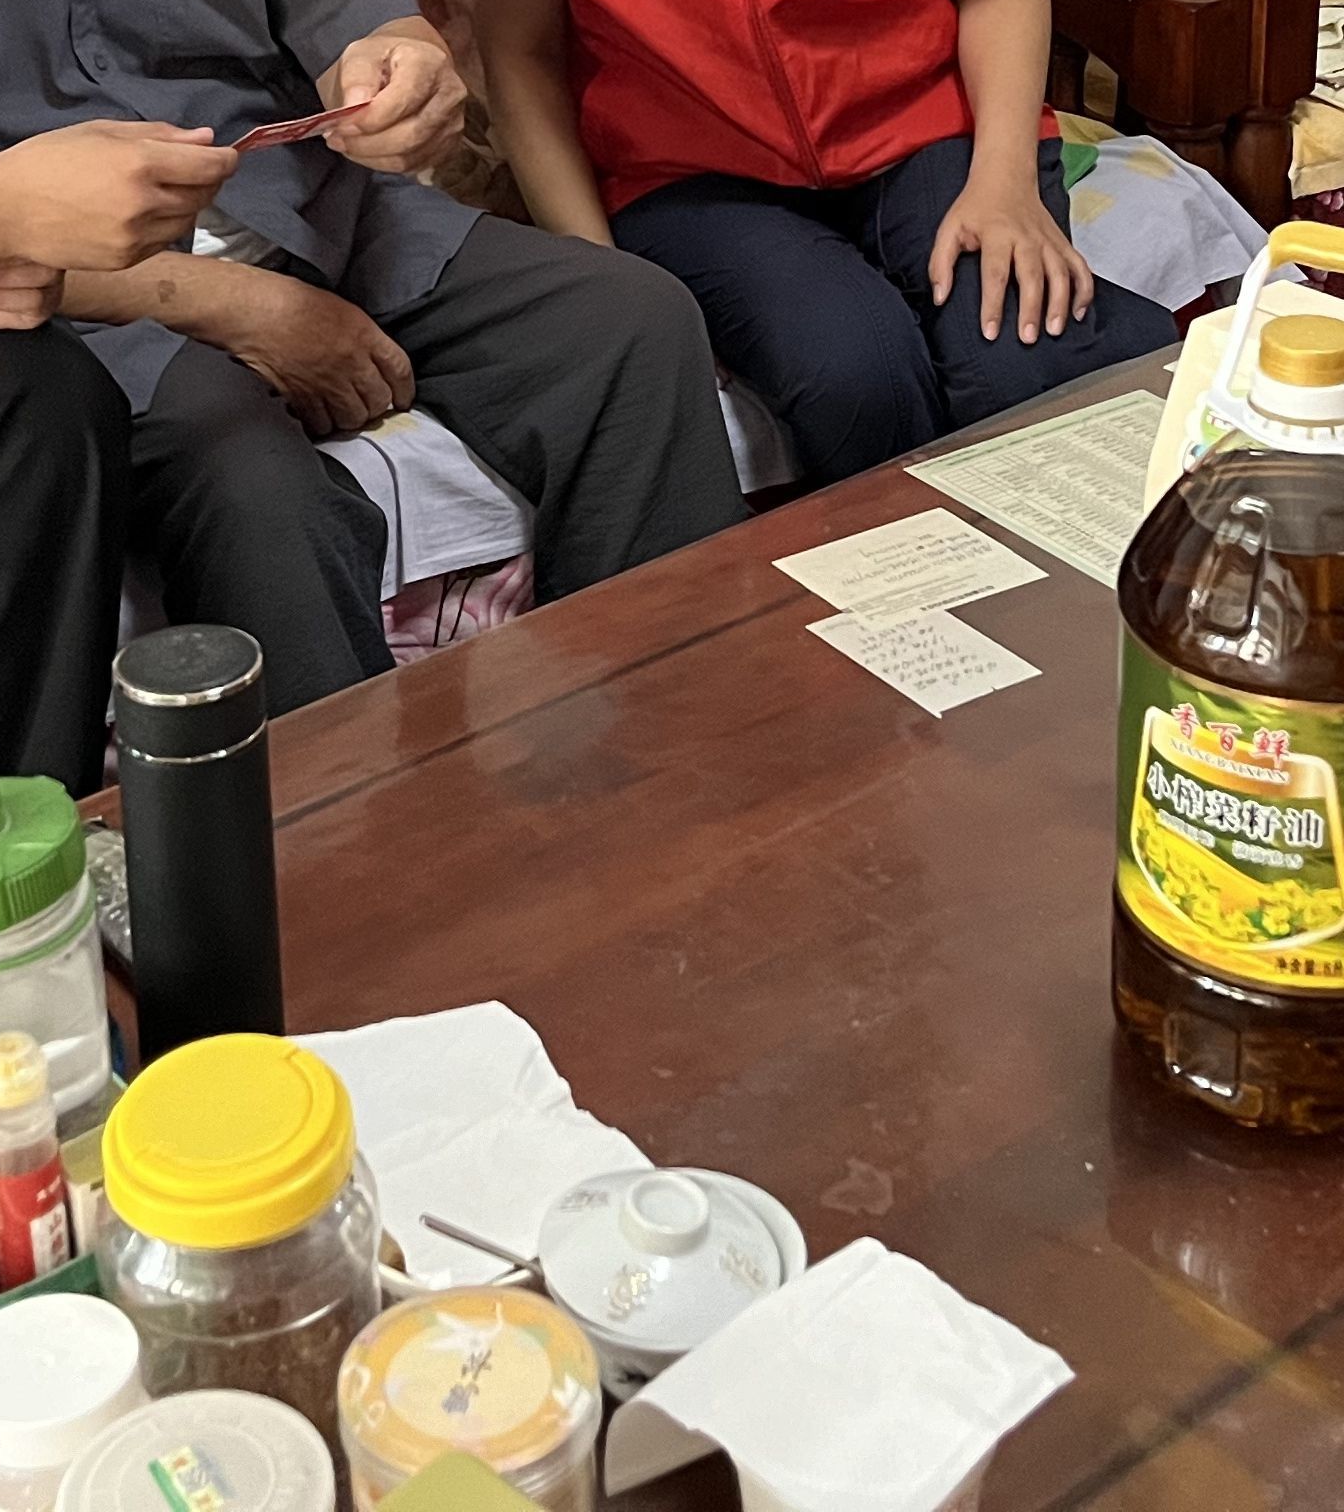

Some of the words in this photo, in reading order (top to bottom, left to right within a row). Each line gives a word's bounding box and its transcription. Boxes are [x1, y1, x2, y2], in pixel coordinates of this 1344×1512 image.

[1146, 762, 1325, 849] 小榨菜籽油
